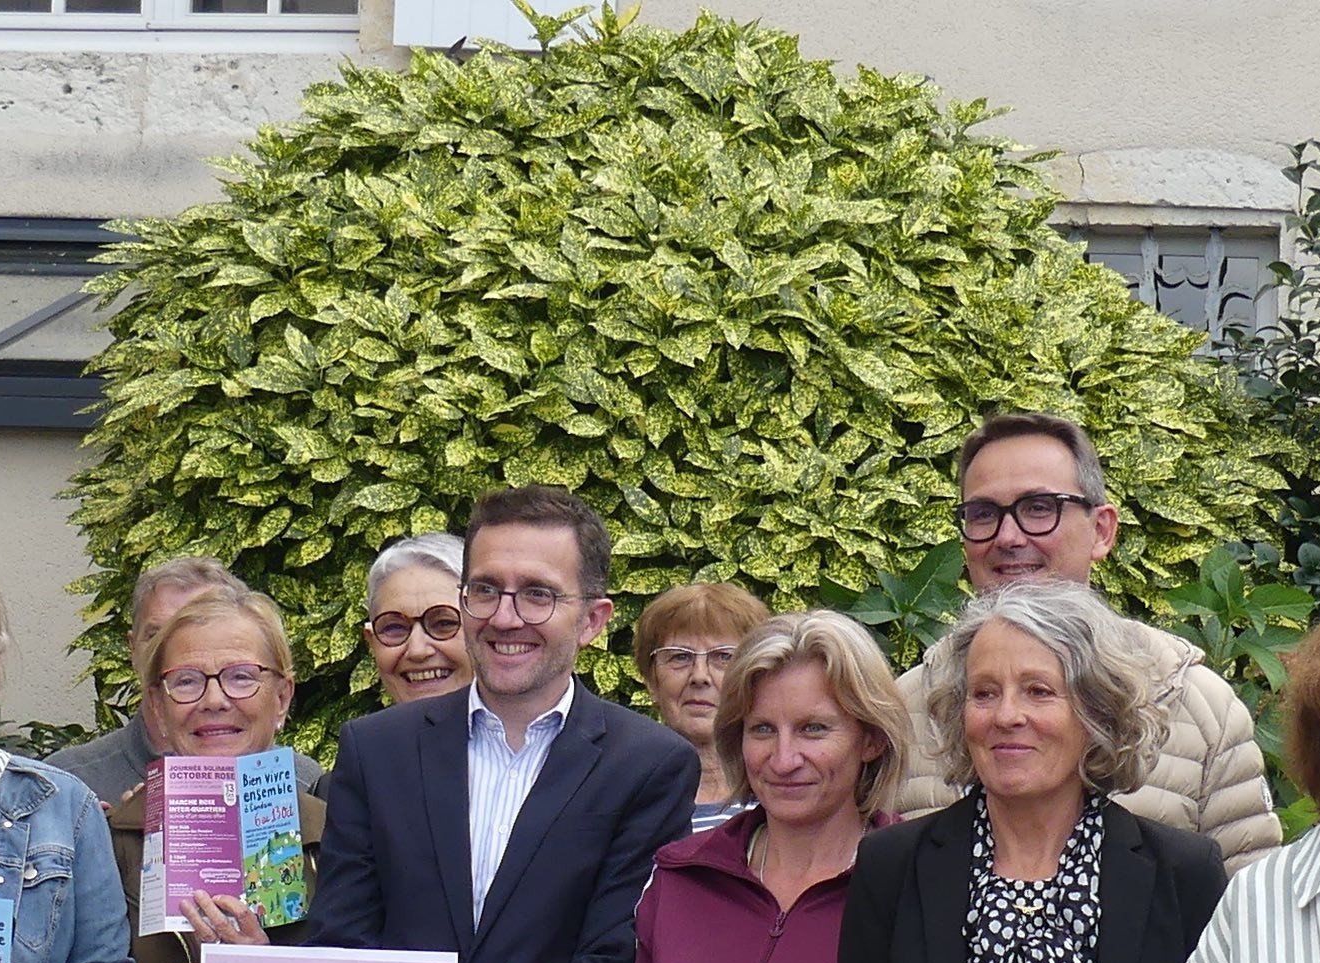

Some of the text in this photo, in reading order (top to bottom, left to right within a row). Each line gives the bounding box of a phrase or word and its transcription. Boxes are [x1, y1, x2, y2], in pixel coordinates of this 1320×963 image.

[169, 772, 235, 780] OCTOBRE ROSE
[243, 770, 291, 788] Bien vivre
[243, 783, 293, 802] ensemble
